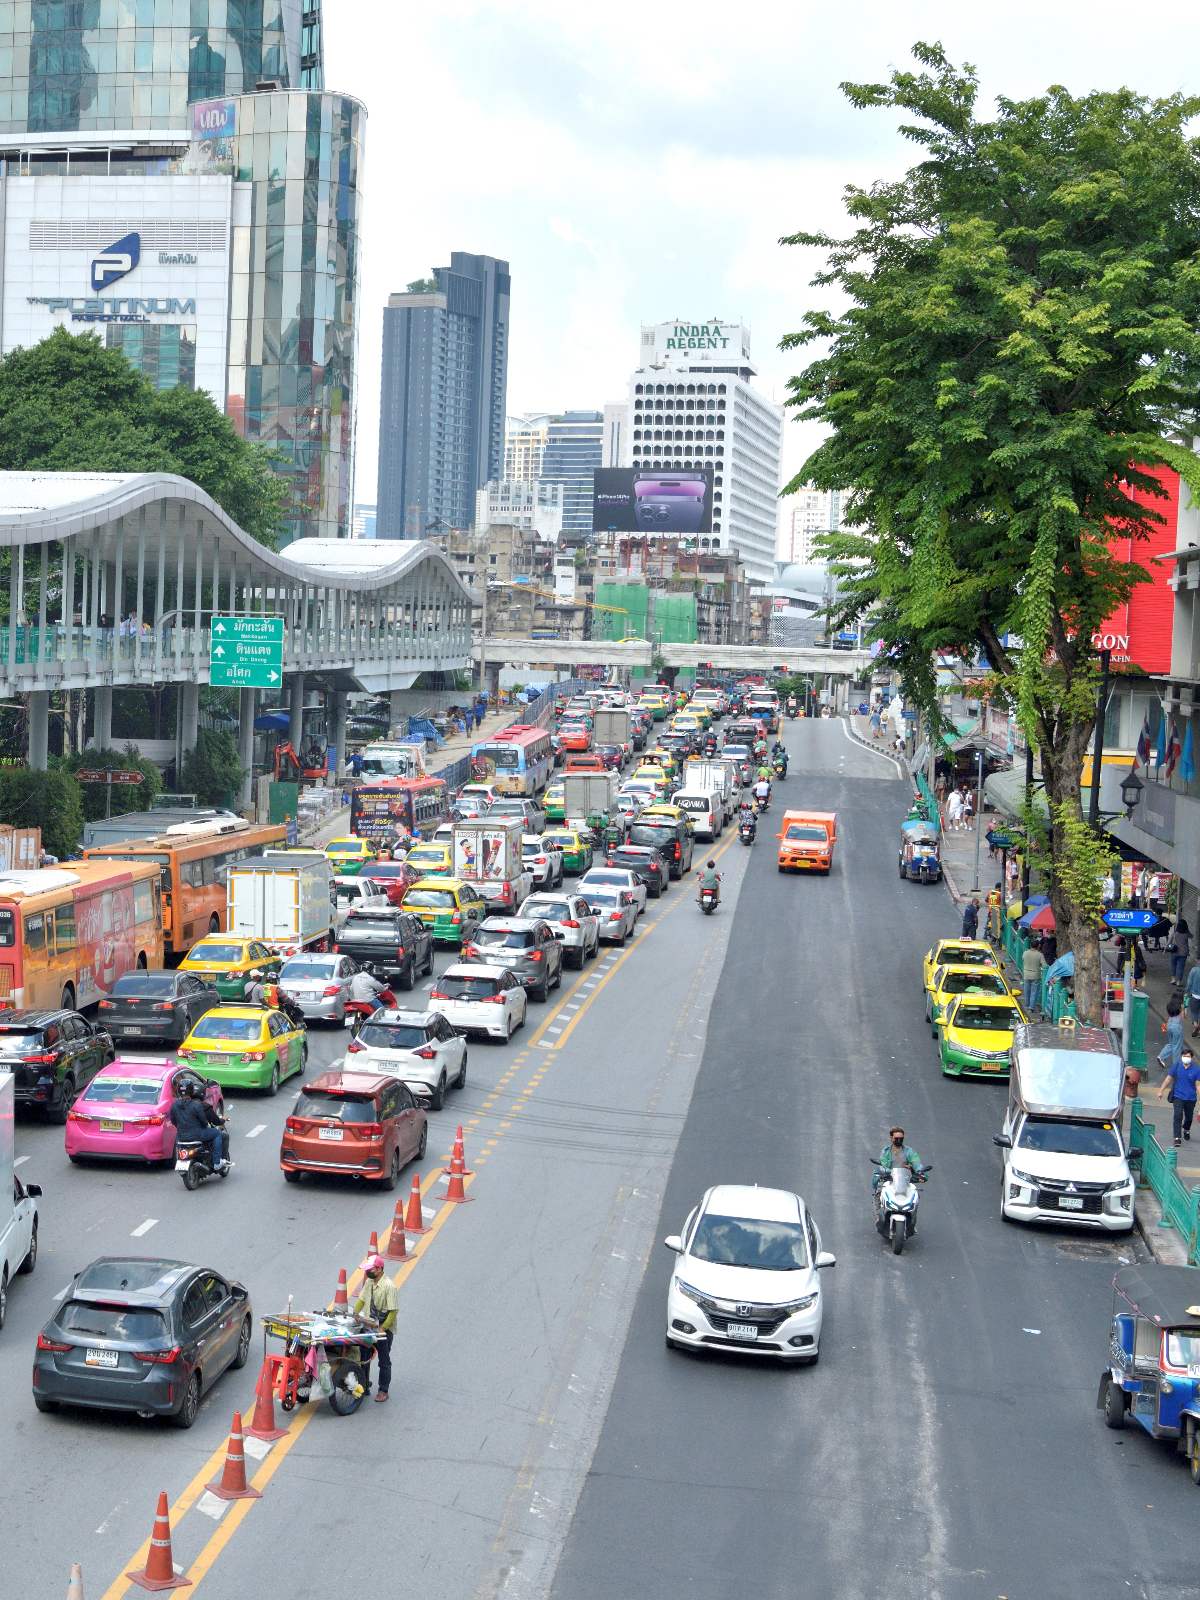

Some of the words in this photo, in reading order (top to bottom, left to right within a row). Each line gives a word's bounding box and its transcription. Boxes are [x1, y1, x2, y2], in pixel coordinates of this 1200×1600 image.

[72, 314, 117, 322] FASHION
[120, 314, 150, 322] MALL
[674, 326, 722, 338] INDRA
[666, 338, 730, 350] REGENT
[234, 619, 274, 632] มักกะสัน
[236, 642, 271, 655] ดินแดง
[226, 664, 251, 678] อโศก
[1144, 914, 1150, 923] 2
